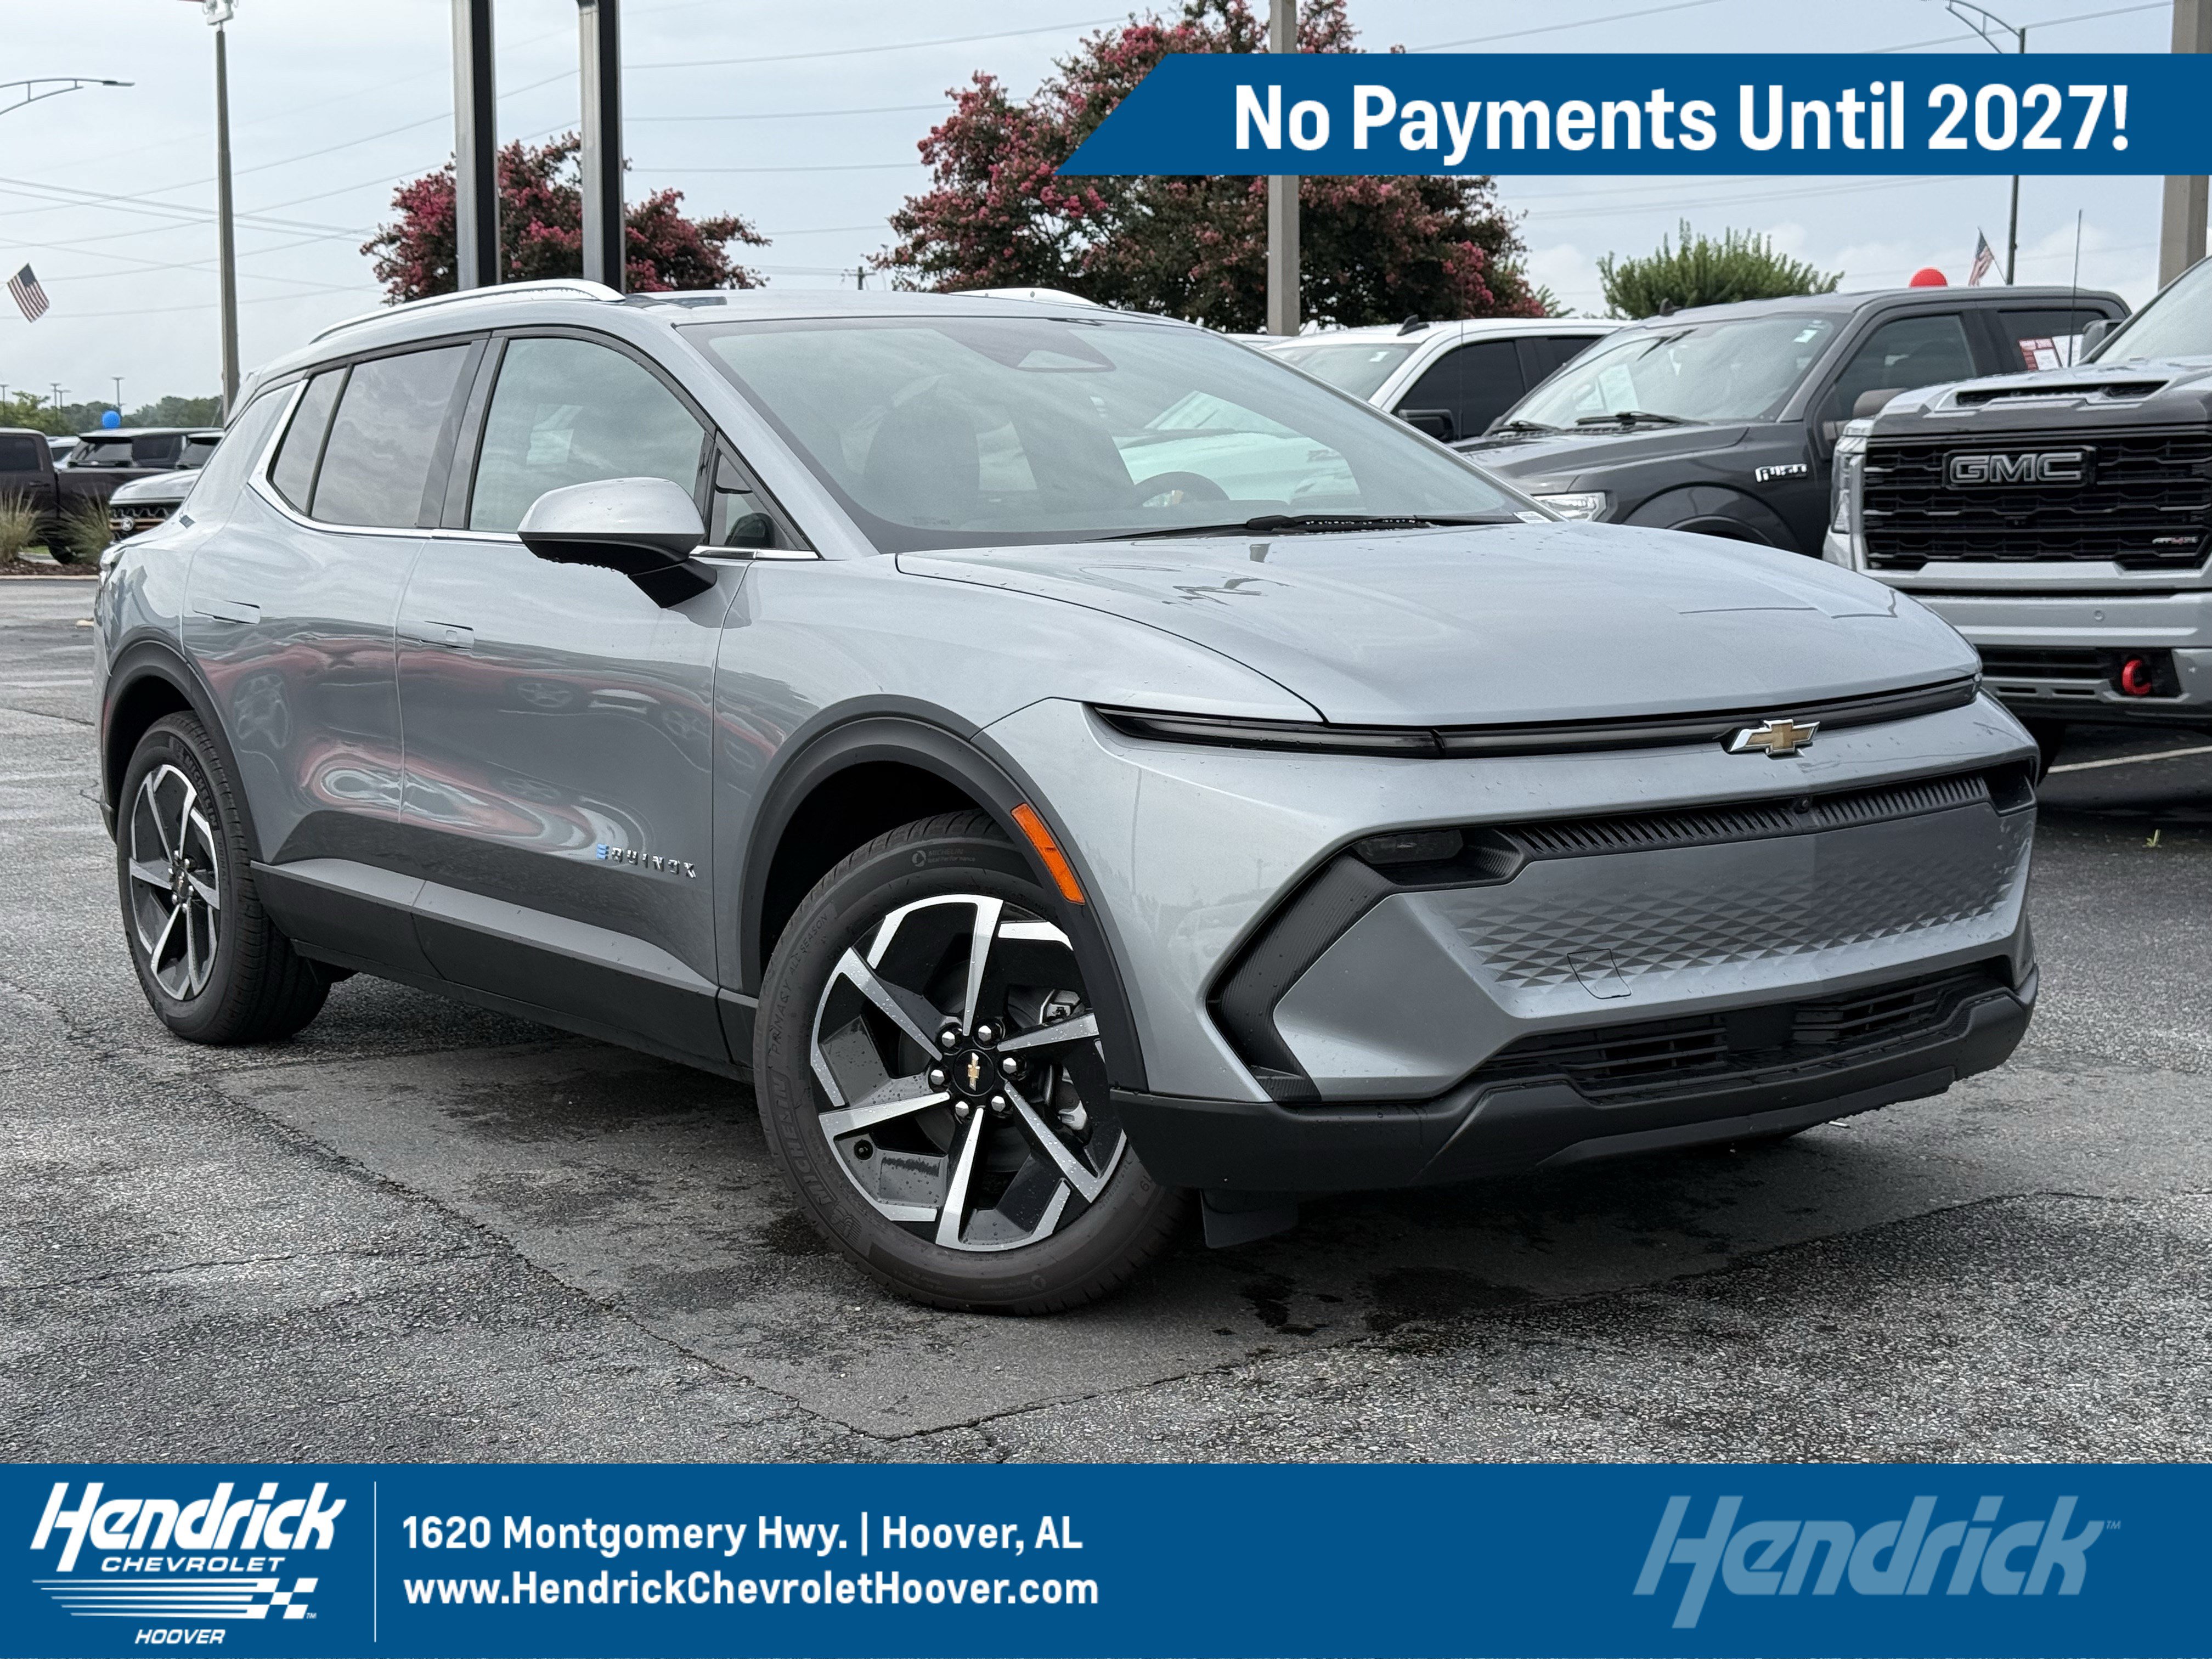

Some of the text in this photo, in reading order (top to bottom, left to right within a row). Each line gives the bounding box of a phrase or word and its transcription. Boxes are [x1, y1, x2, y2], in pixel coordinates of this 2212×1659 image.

[1950, 453, 2082, 483] GMC
[799, 913, 829, 955] SEASON
[772, 1075, 833, 1207] MICHELIN
